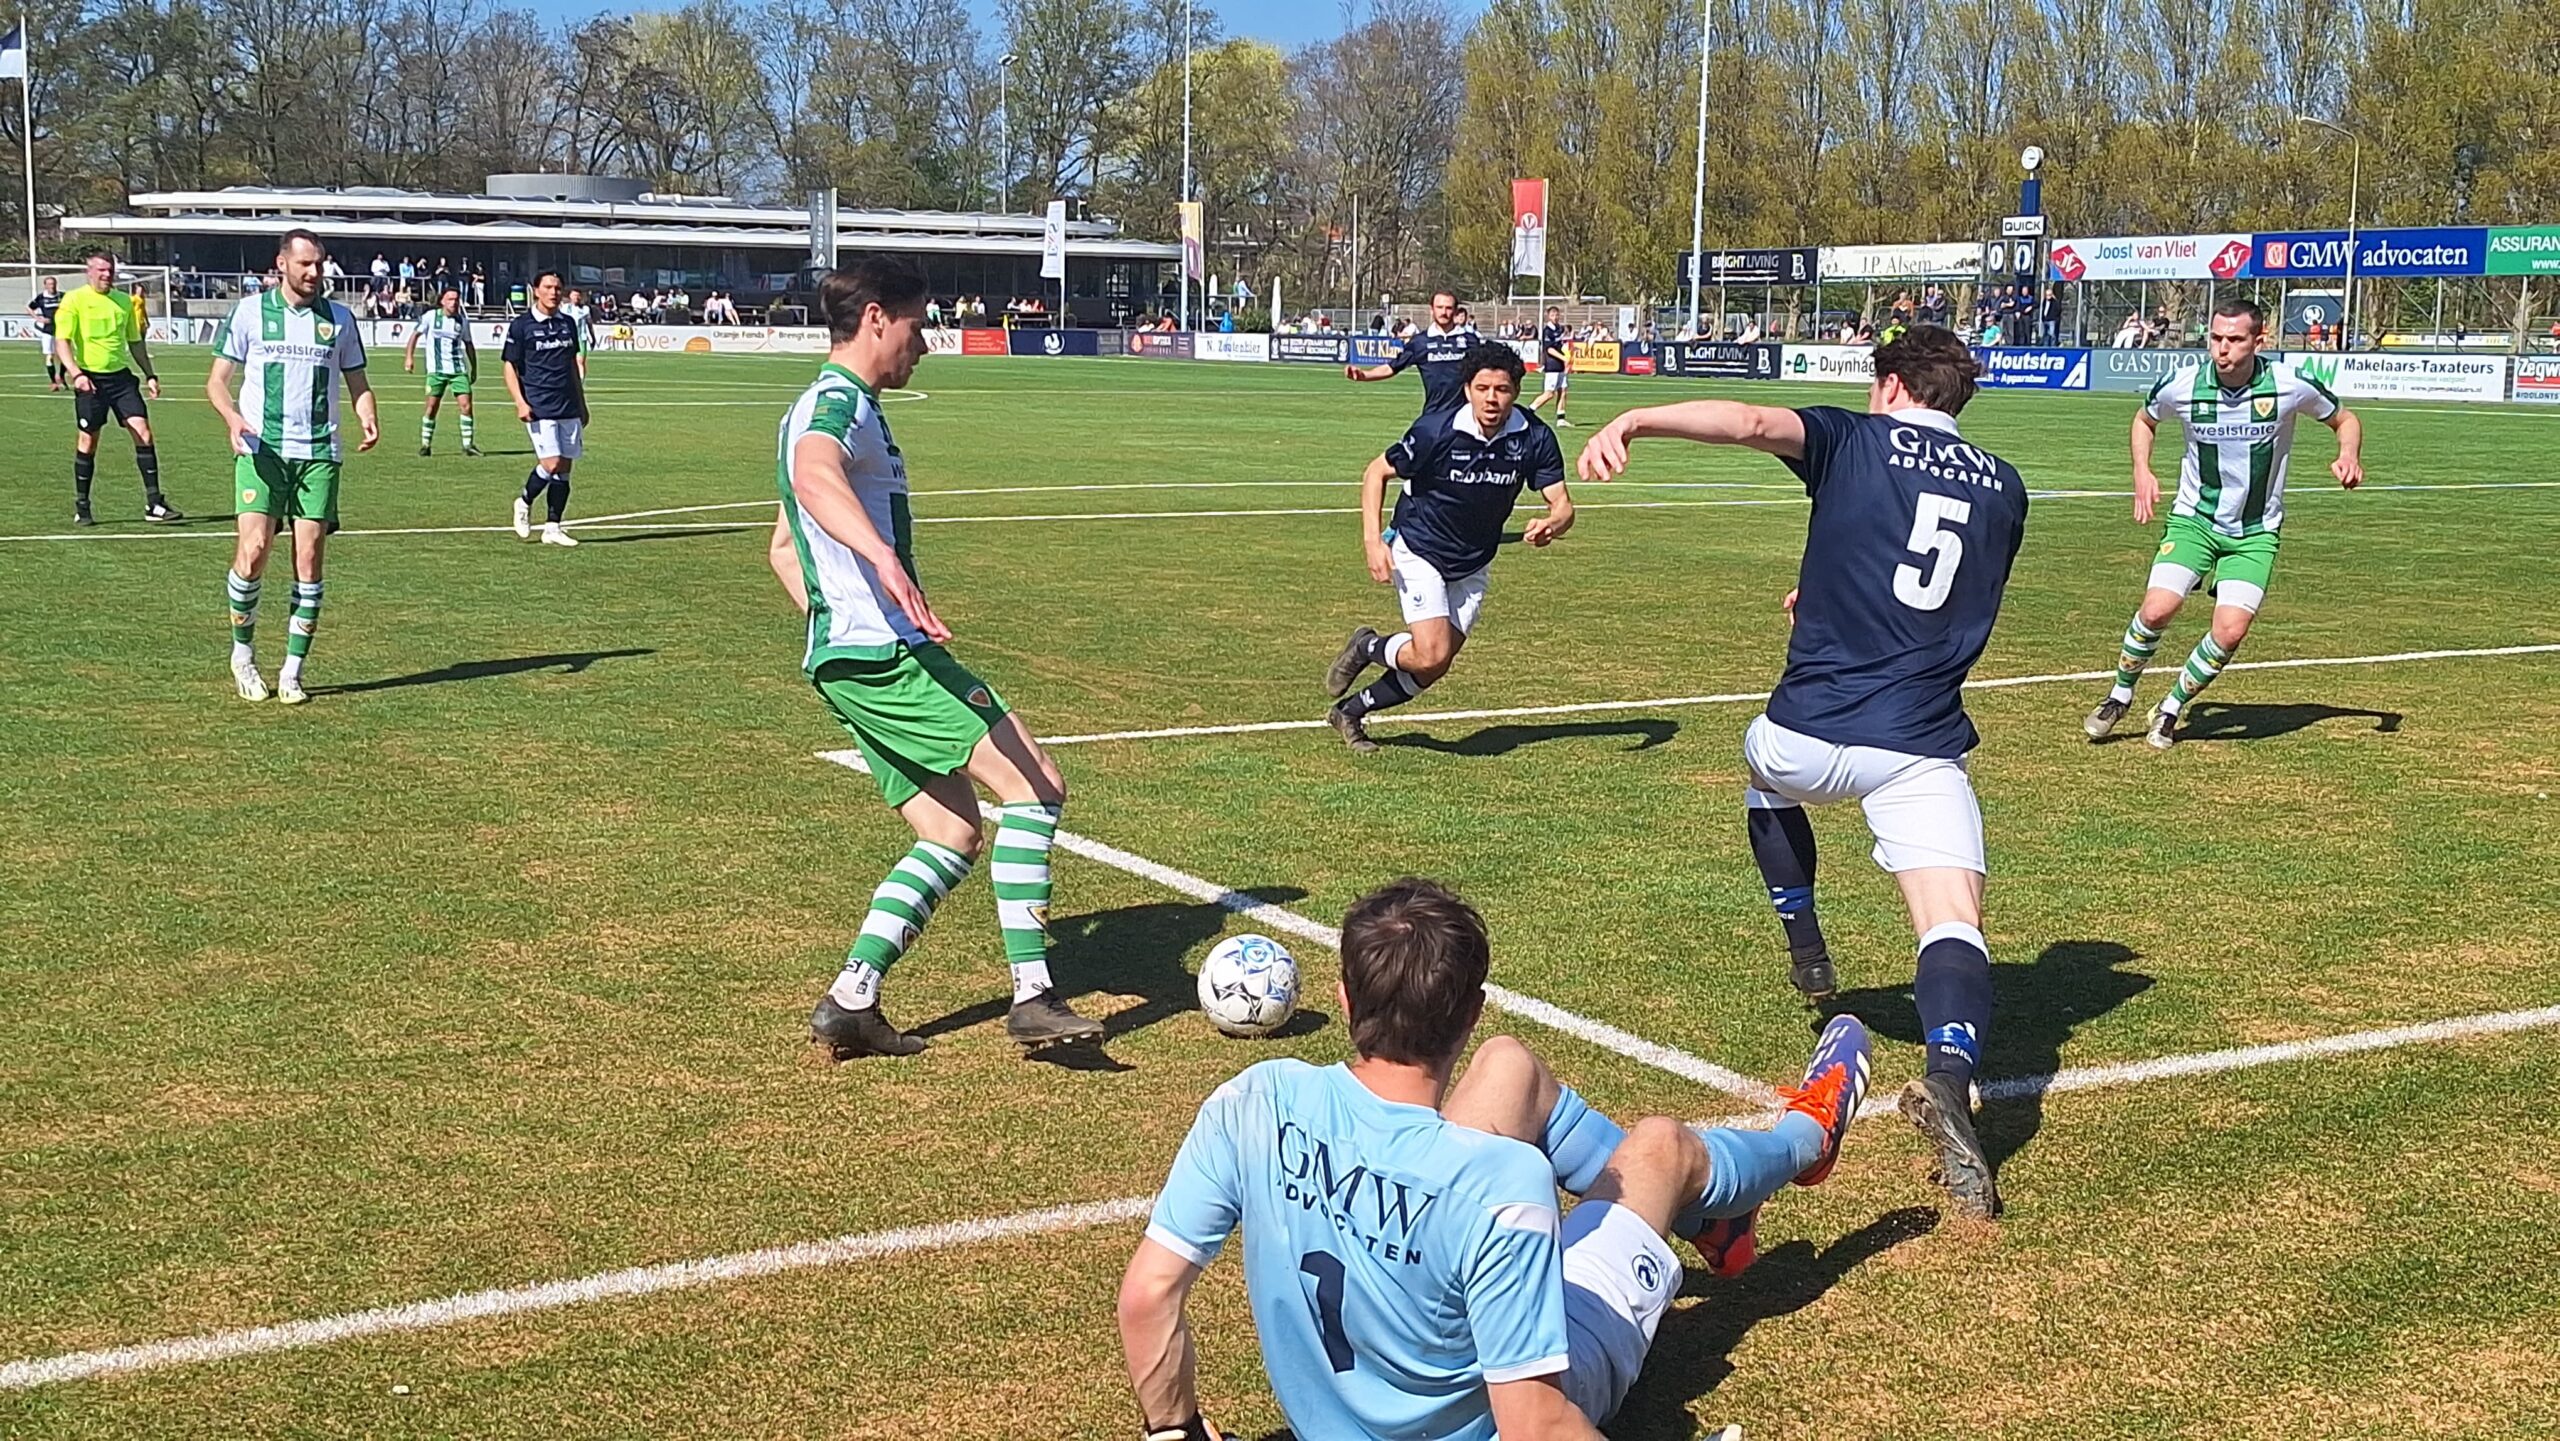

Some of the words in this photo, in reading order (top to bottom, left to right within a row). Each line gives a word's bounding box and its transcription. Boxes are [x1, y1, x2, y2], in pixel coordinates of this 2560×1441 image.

[2004, 220, 2041, 232] QUICK
[1711, 255, 1746, 269] BRGHT
[1746, 254, 1779, 268] LIVING
[2094, 243, 2132, 260] Joost
[2137, 245, 2162, 258] van
[2165, 240, 2197, 257] Vliet
[2290, 241, 2360, 268] GMW
[2362, 240, 2468, 267] advocaten
[1988, 351, 2065, 370] Houtstra
[2344, 358, 2494, 375] Makelaars-Taxateurs
[2518, 357, 2560, 382] Zegw
[2194, 423, 2276, 438] weststrate
[1889, 426, 1997, 476] GMW
[1888, 454, 2003, 492] ADVOCATEN
[1892, 491, 1971, 611] 5
[1278, 1121, 1438, 1240] GMW
[1277, 1180, 1422, 1265] DVOCTEN
[1300, 1249, 1356, 1374] 1
